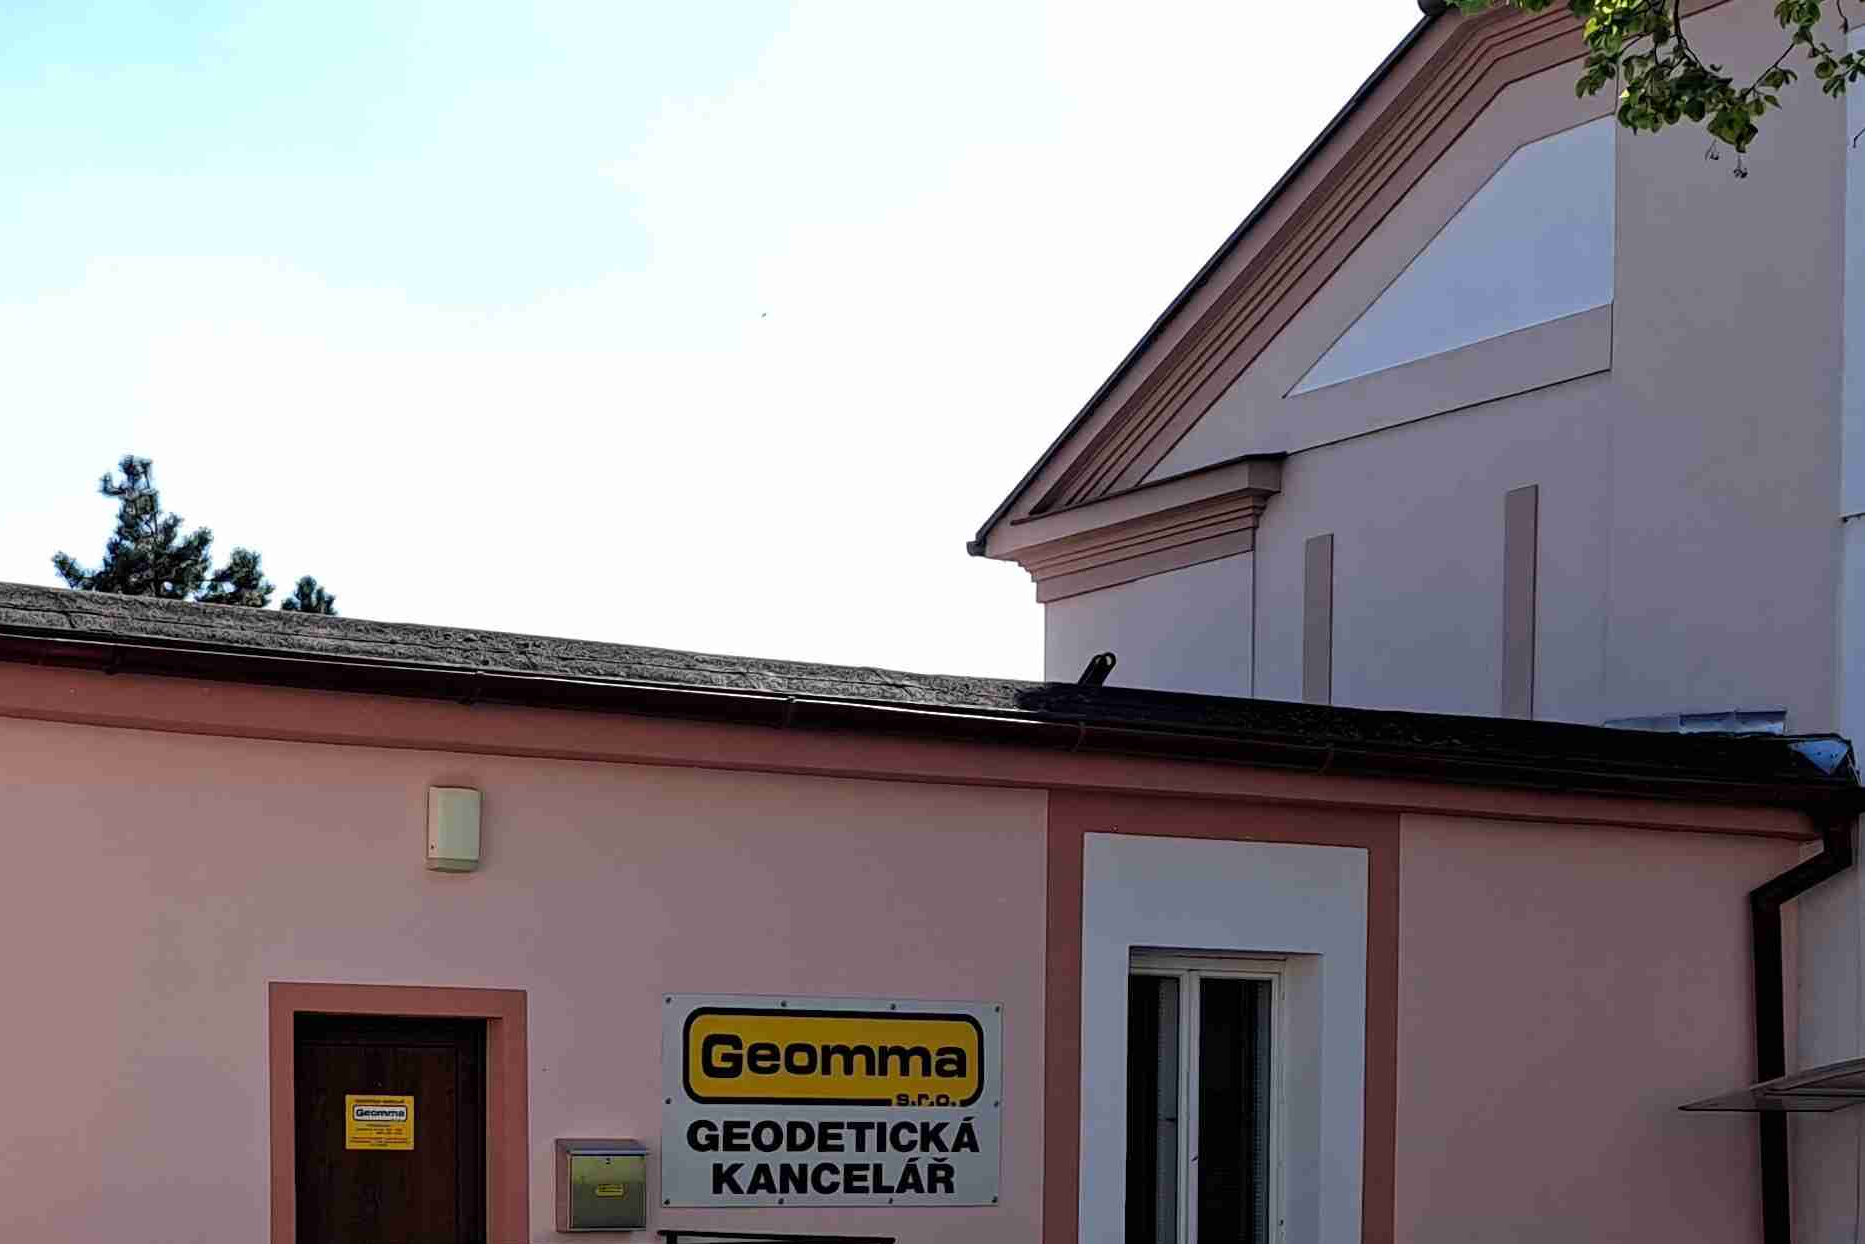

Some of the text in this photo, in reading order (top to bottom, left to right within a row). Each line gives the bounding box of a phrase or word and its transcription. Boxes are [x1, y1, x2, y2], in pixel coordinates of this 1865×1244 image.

[700, 1033, 967, 1079] Geomma
[896, 1094, 958, 1108] s.r.o.
[686, 1117, 981, 1153] GEODETICKÁ
[712, 1157, 956, 1195] KANCELÁŘ
